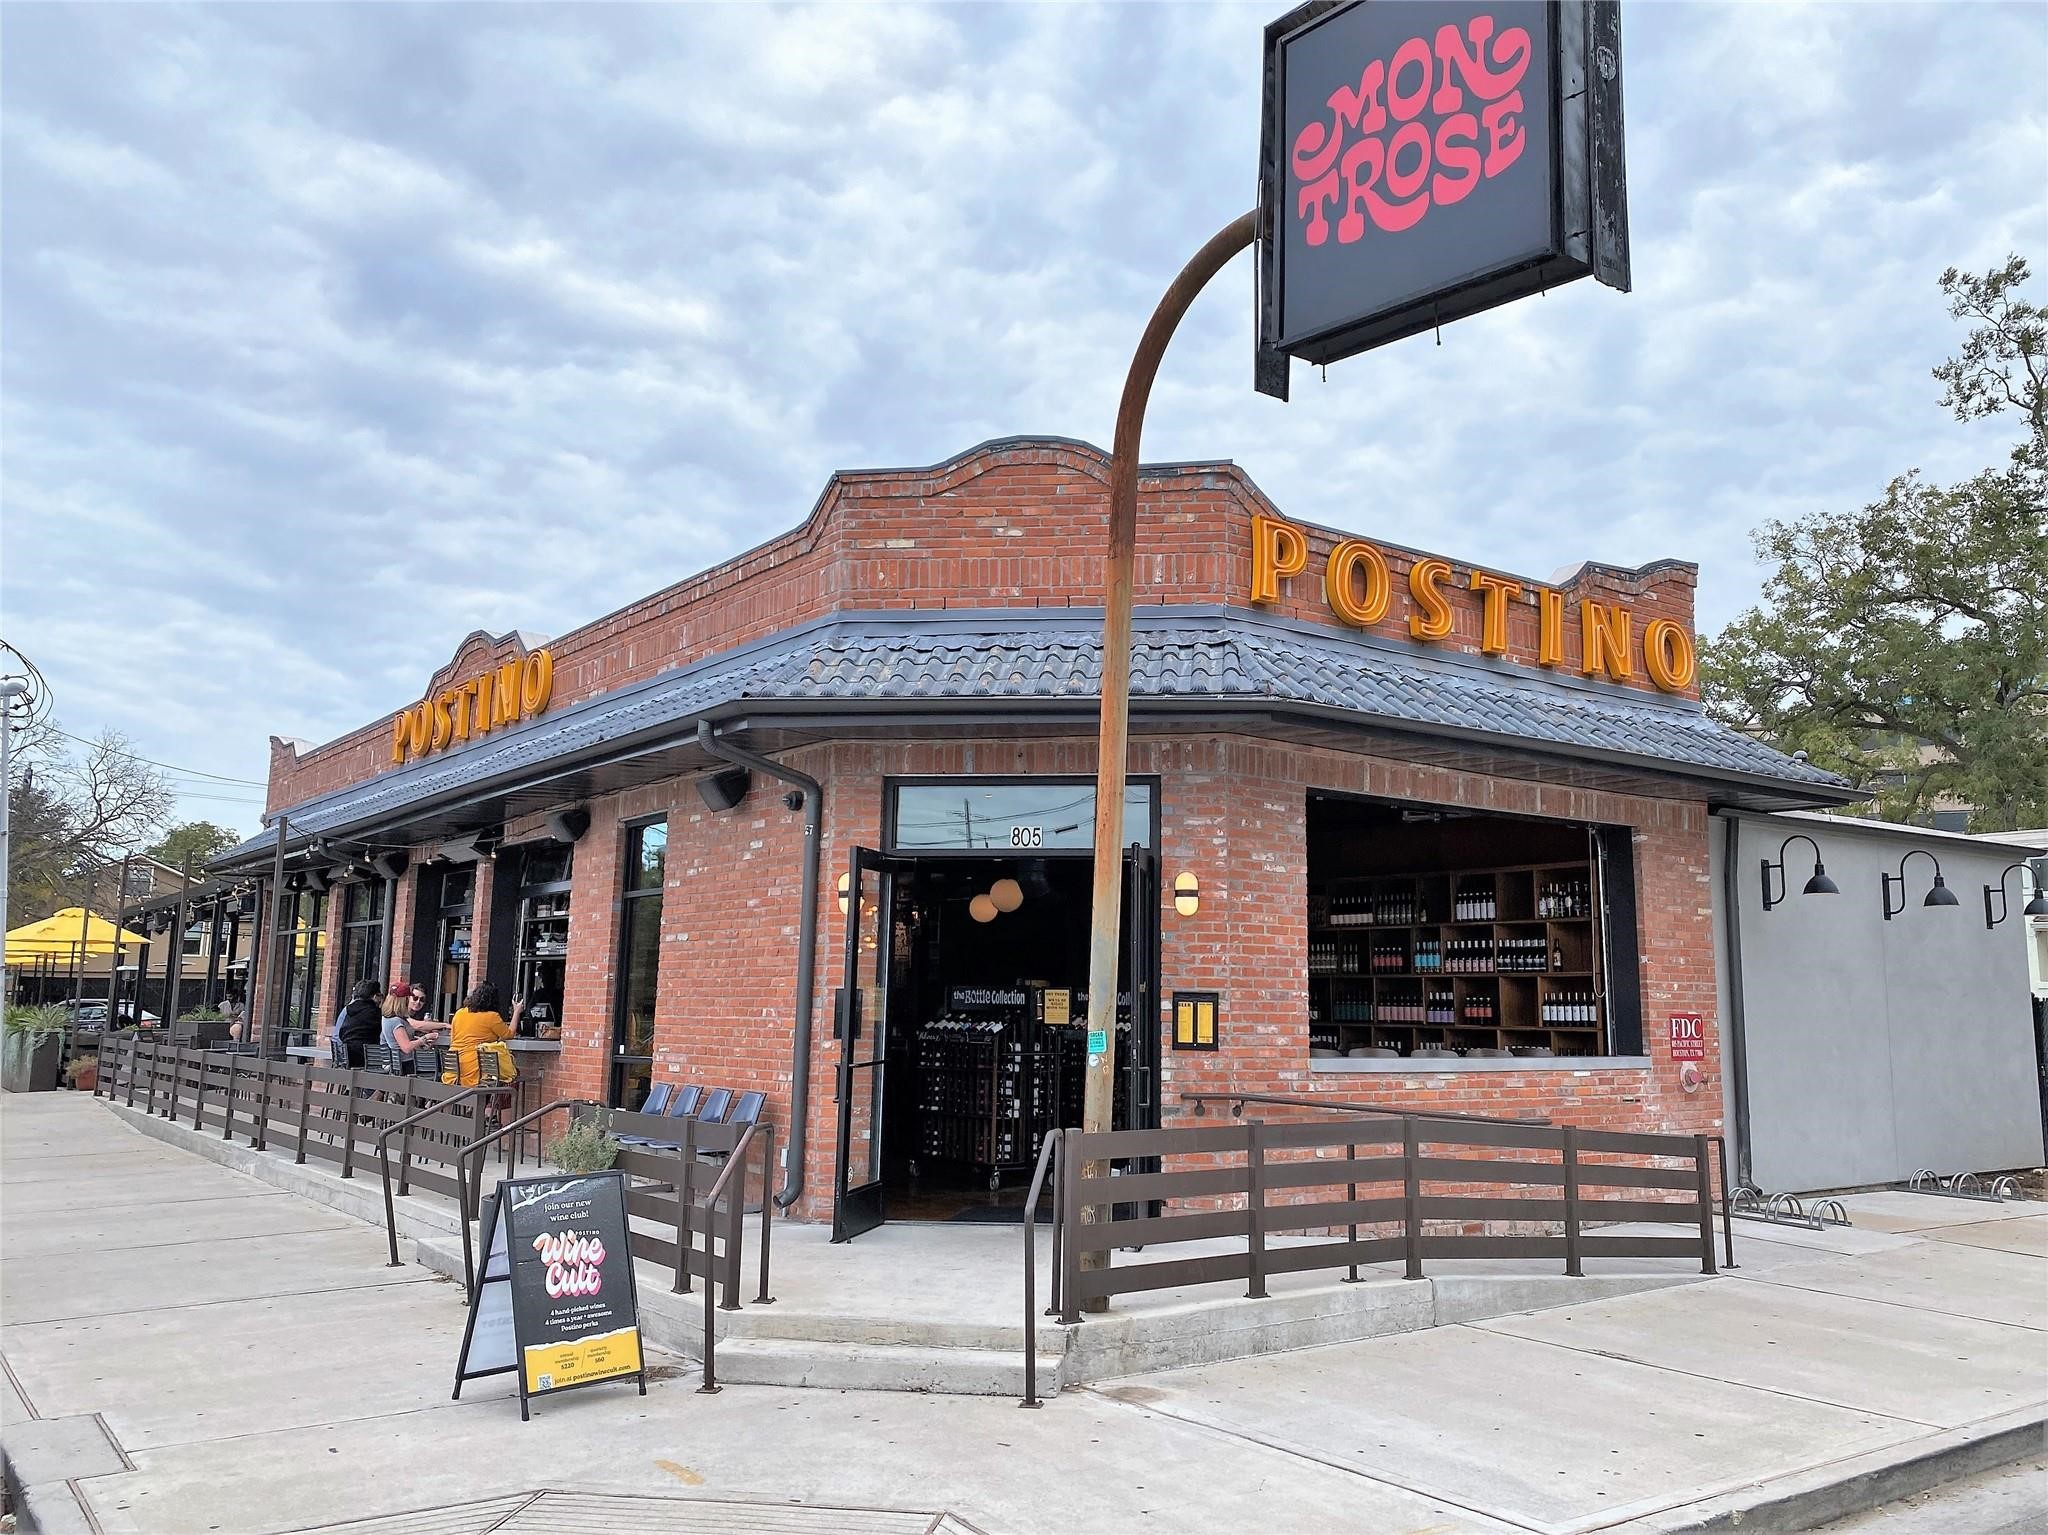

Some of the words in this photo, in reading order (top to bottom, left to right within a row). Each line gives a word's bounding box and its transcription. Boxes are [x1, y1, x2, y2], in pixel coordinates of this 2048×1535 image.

[1292, 16, 1531, 181] MON
[1298, 90, 1525, 246] TROSE
[1251, 514, 1694, 692] POSTINO
[392, 649, 553, 763] POSTINO
[1012, 827, 1041, 846] 805
[991, 989, 1025, 1005] Collection
[1671, 1018, 1702, 1039] FDC
[575, 1200, 592, 1208] new
[550, 1213, 569, 1222] wine
[570, 1210, 589, 1219] club!
[532, 1229, 606, 1267] Wine
[545, 1260, 602, 1298] Cult
[589, 1302, 606, 1310] wines
[549, 1317, 566, 1325] times
[571, 1315, 584, 1323] year
[561, 1322, 582, 1332] Postino
[583, 1320, 599, 1330] perks
